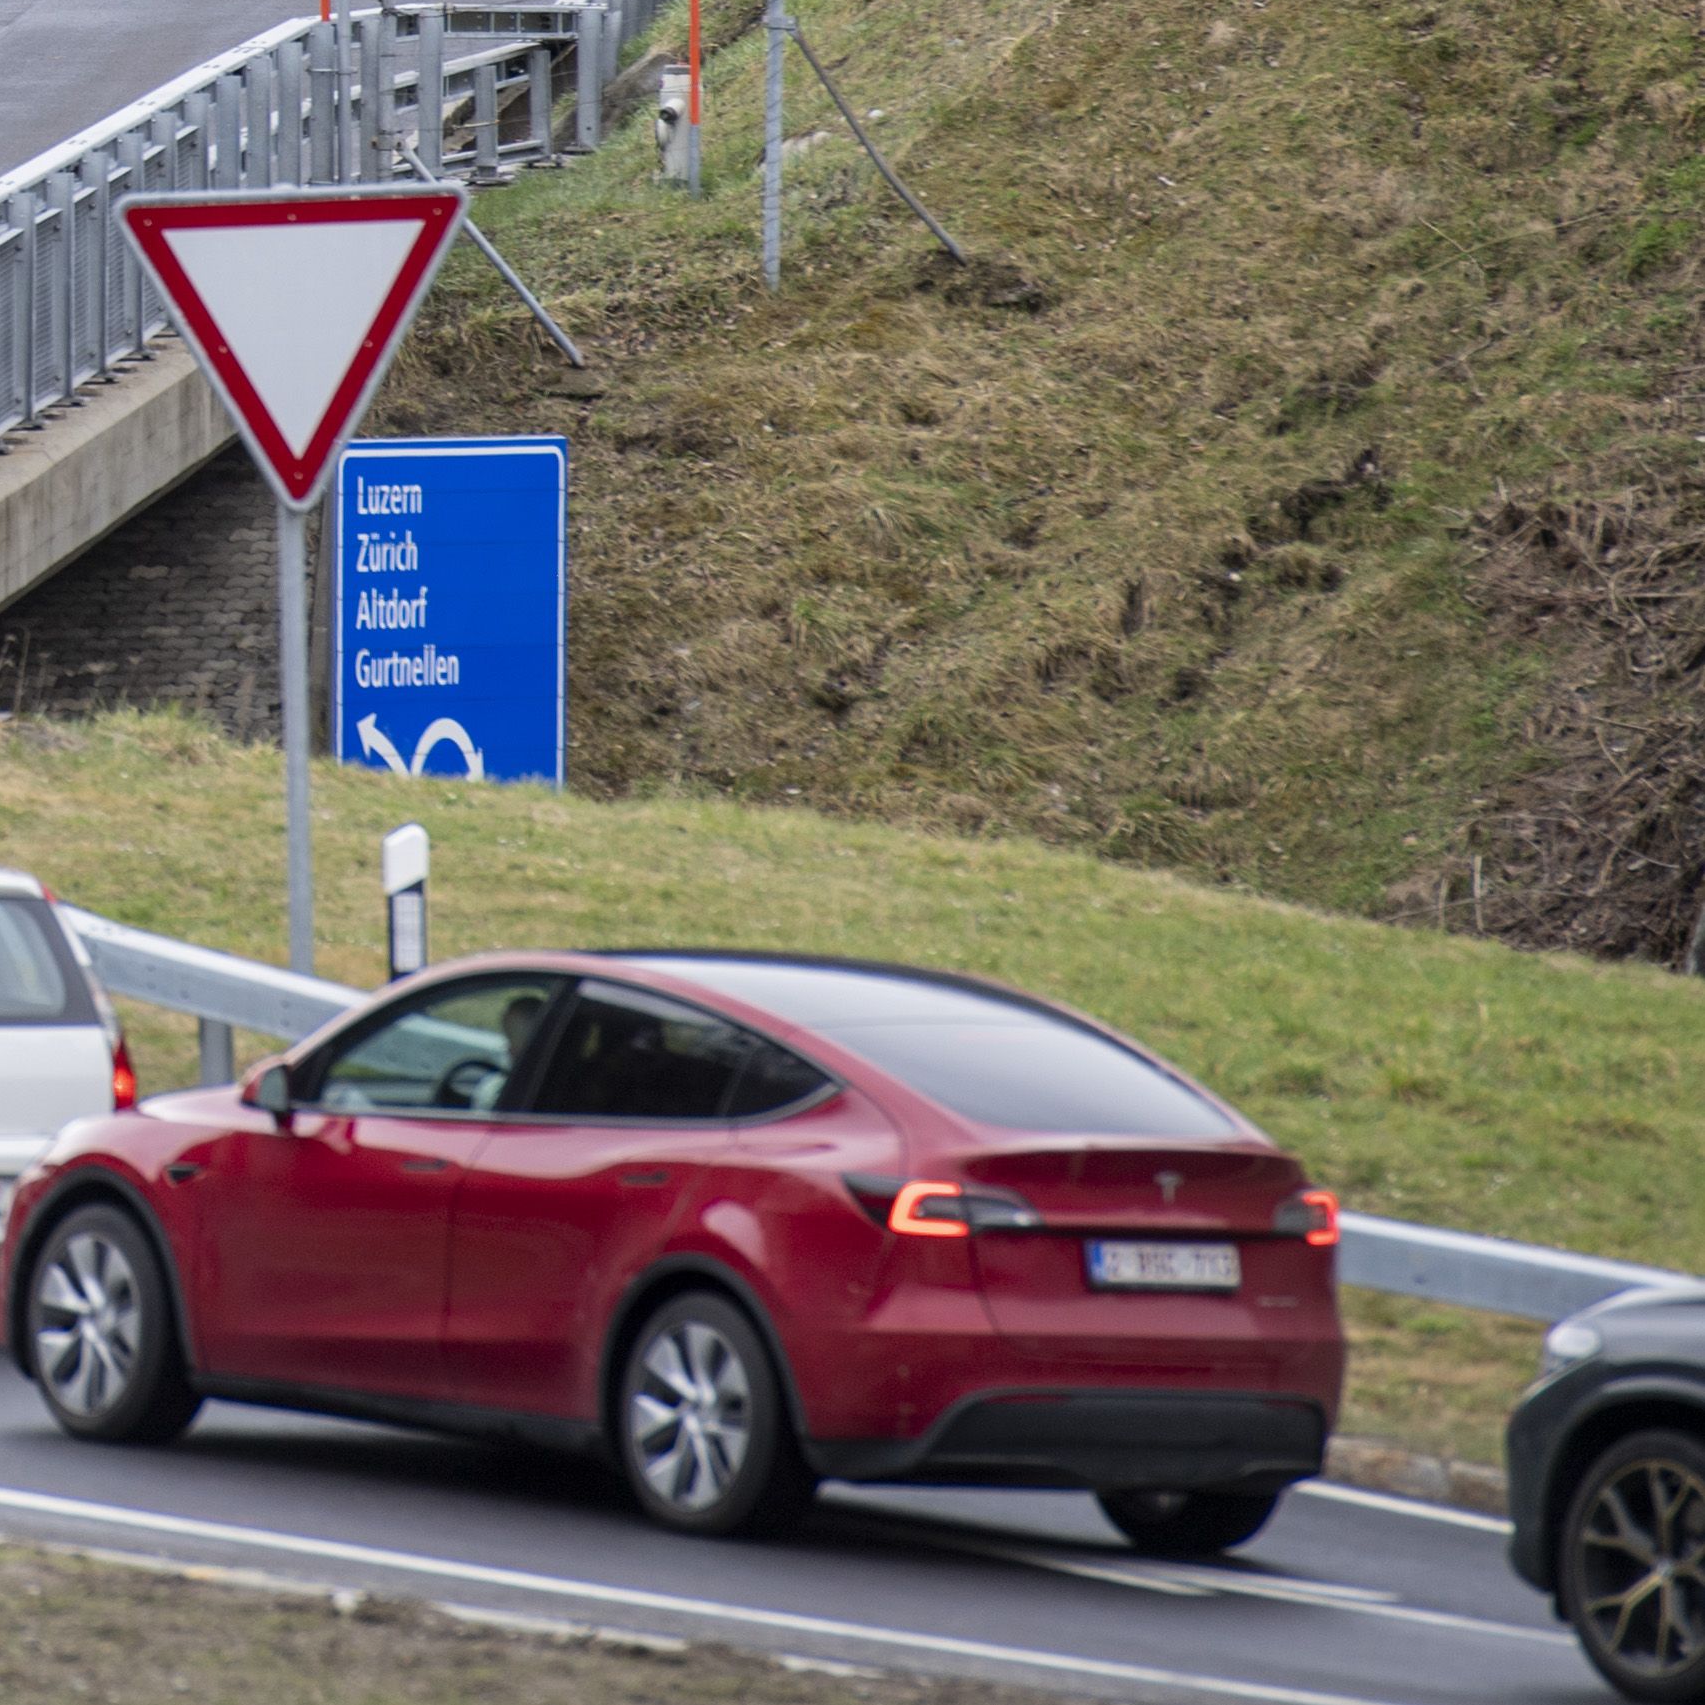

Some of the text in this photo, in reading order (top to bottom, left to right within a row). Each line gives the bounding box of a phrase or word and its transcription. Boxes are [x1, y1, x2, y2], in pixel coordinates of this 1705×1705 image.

[357, 475, 422, 515] Luzern
[356, 530, 418, 573] Zürich
[355, 586, 428, 630] Altdorf
[355, 644, 459, 688] Gurtnellen
